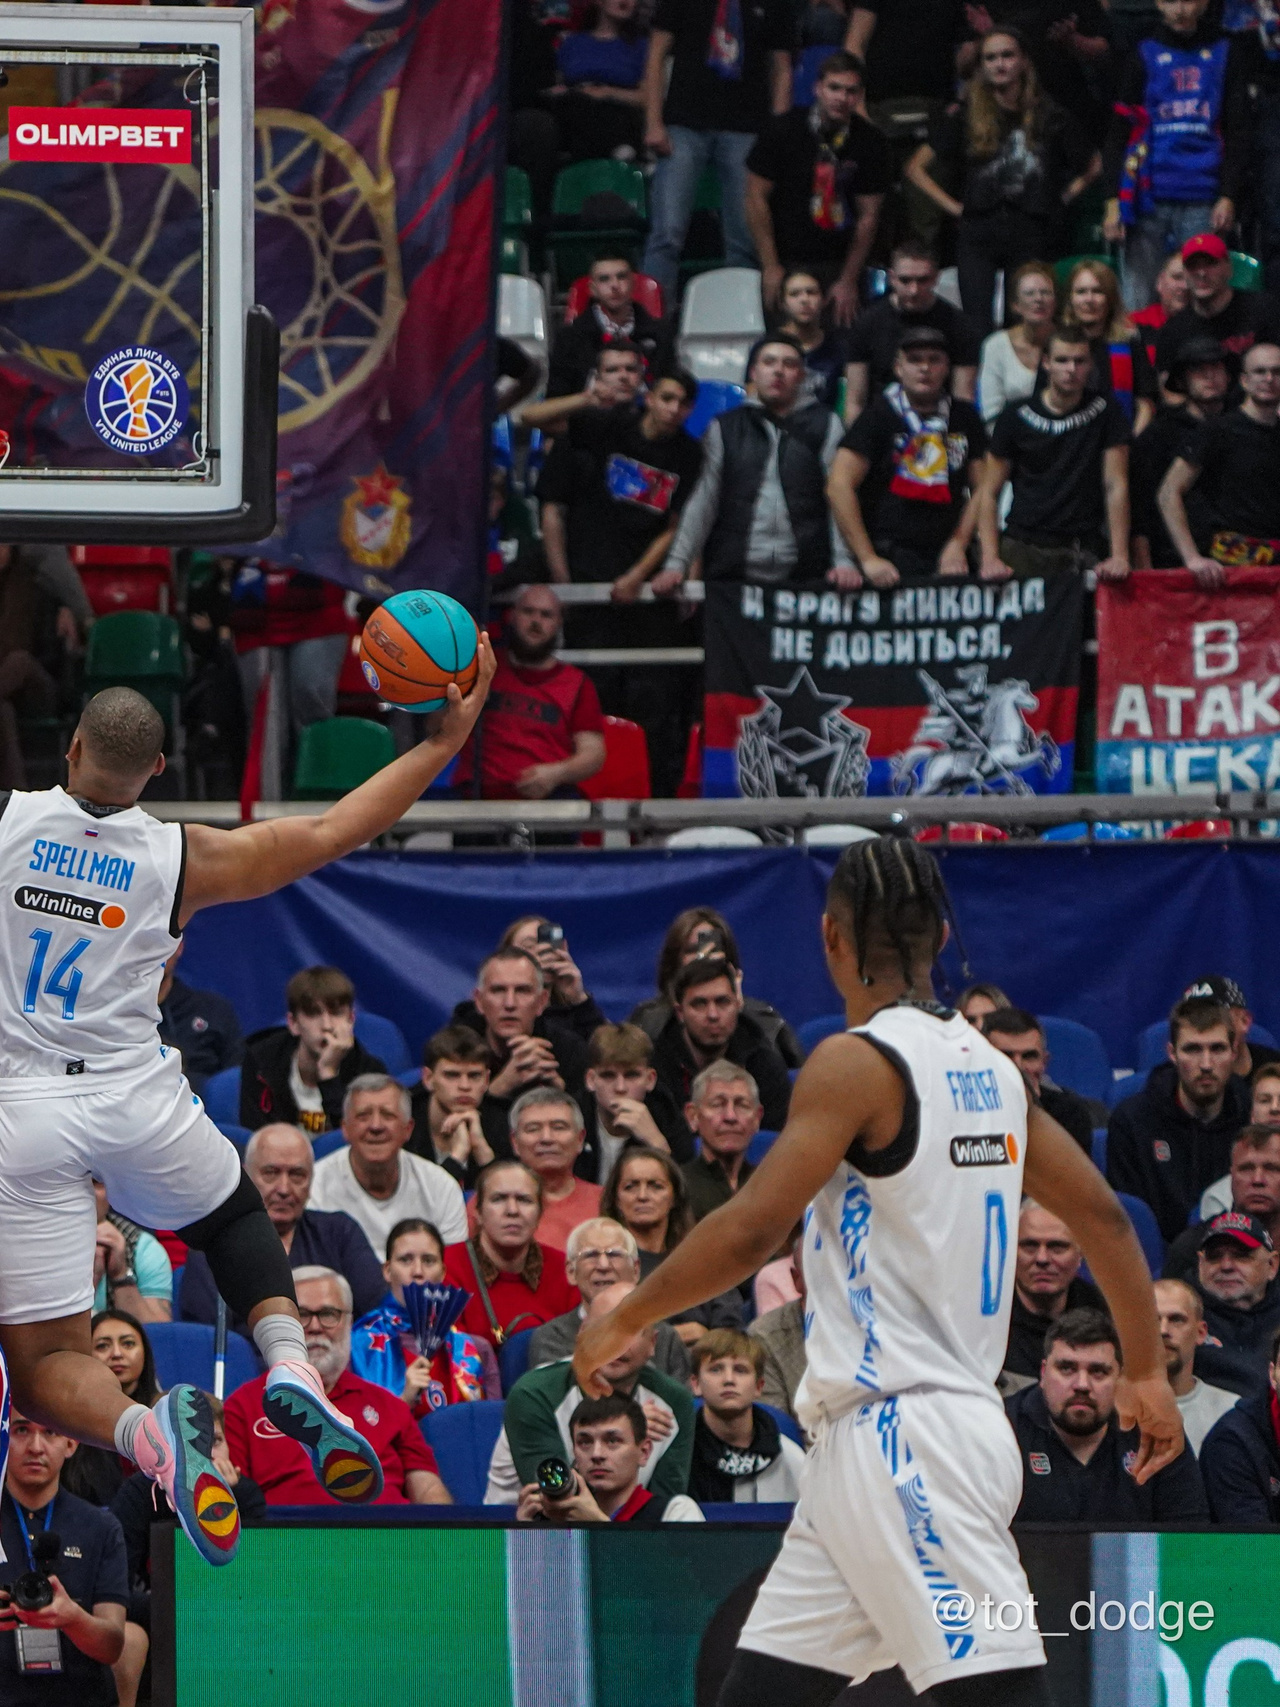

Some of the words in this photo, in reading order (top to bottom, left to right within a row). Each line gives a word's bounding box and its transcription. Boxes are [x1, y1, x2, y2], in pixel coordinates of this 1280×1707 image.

[1171, 67, 1201, 92] 12
[15, 123, 184, 147] OLIMPBET
[94, 348, 133, 380] ЕДИНАЯ
[135, 348, 163, 363] ЛИГА
[163, 359, 181, 380] ВТБ
[95, 419, 111, 439] VTB
[110, 435, 148, 452] UNITED
[148, 419, 183, 451] LEAGUE
[891, 577, 1045, 624] НИКОГДА
[771, 626, 815, 663] НЕ
[823, 622, 1013, 671] ДОБИТЬСЯ,
[1193, 619, 1240, 679] В
[29, 838, 136, 892] SPELLMAN
[23, 888, 95, 920] Winline
[23, 927, 92, 1020] 14
[954, 1139, 1006, 1164] Winline
[980, 1189, 1008, 1317] 0
[426, 1380, 447, 1412] 6
